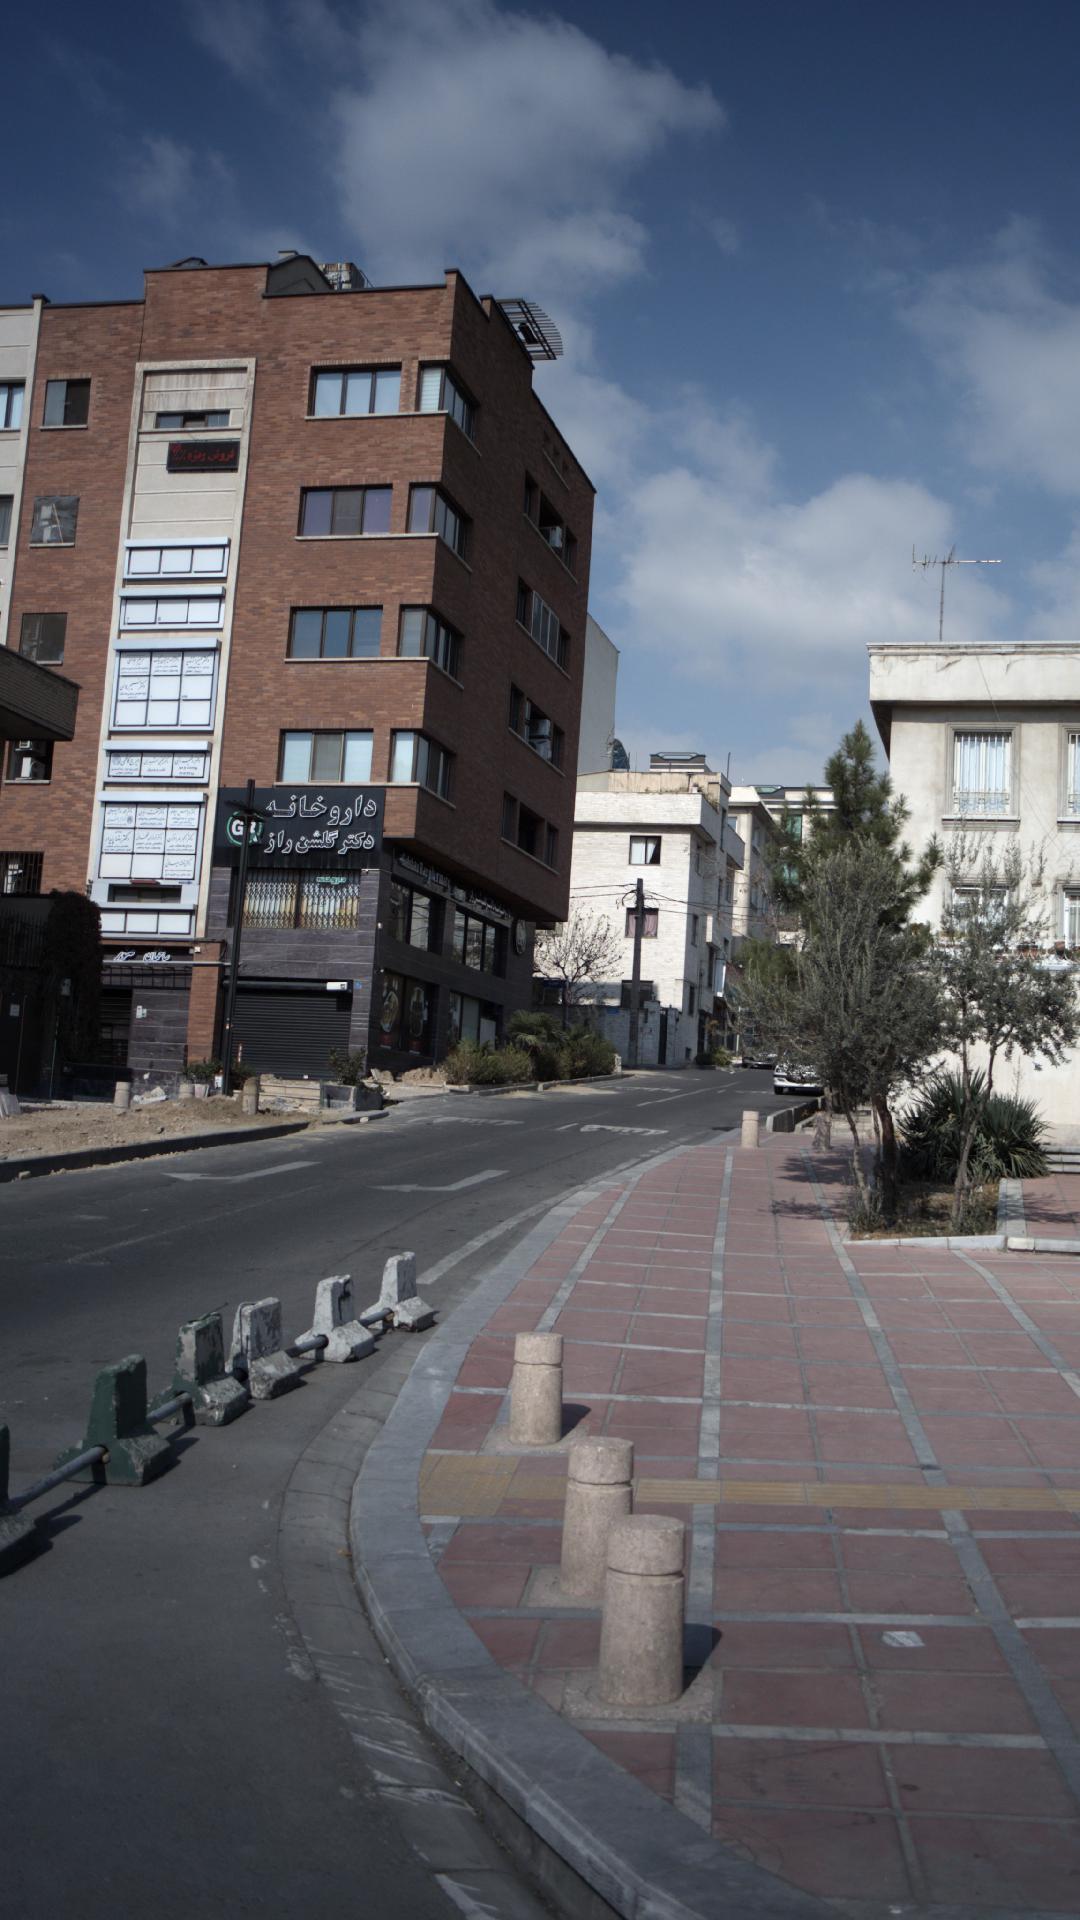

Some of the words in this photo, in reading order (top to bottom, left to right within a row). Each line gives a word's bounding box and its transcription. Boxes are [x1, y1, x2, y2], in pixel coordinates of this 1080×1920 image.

[265, 794, 377, 825] داروخانه
[263, 829, 293, 854] راز
[295, 829, 339, 854] گلشن
[337, 831, 375, 855] دکتر
